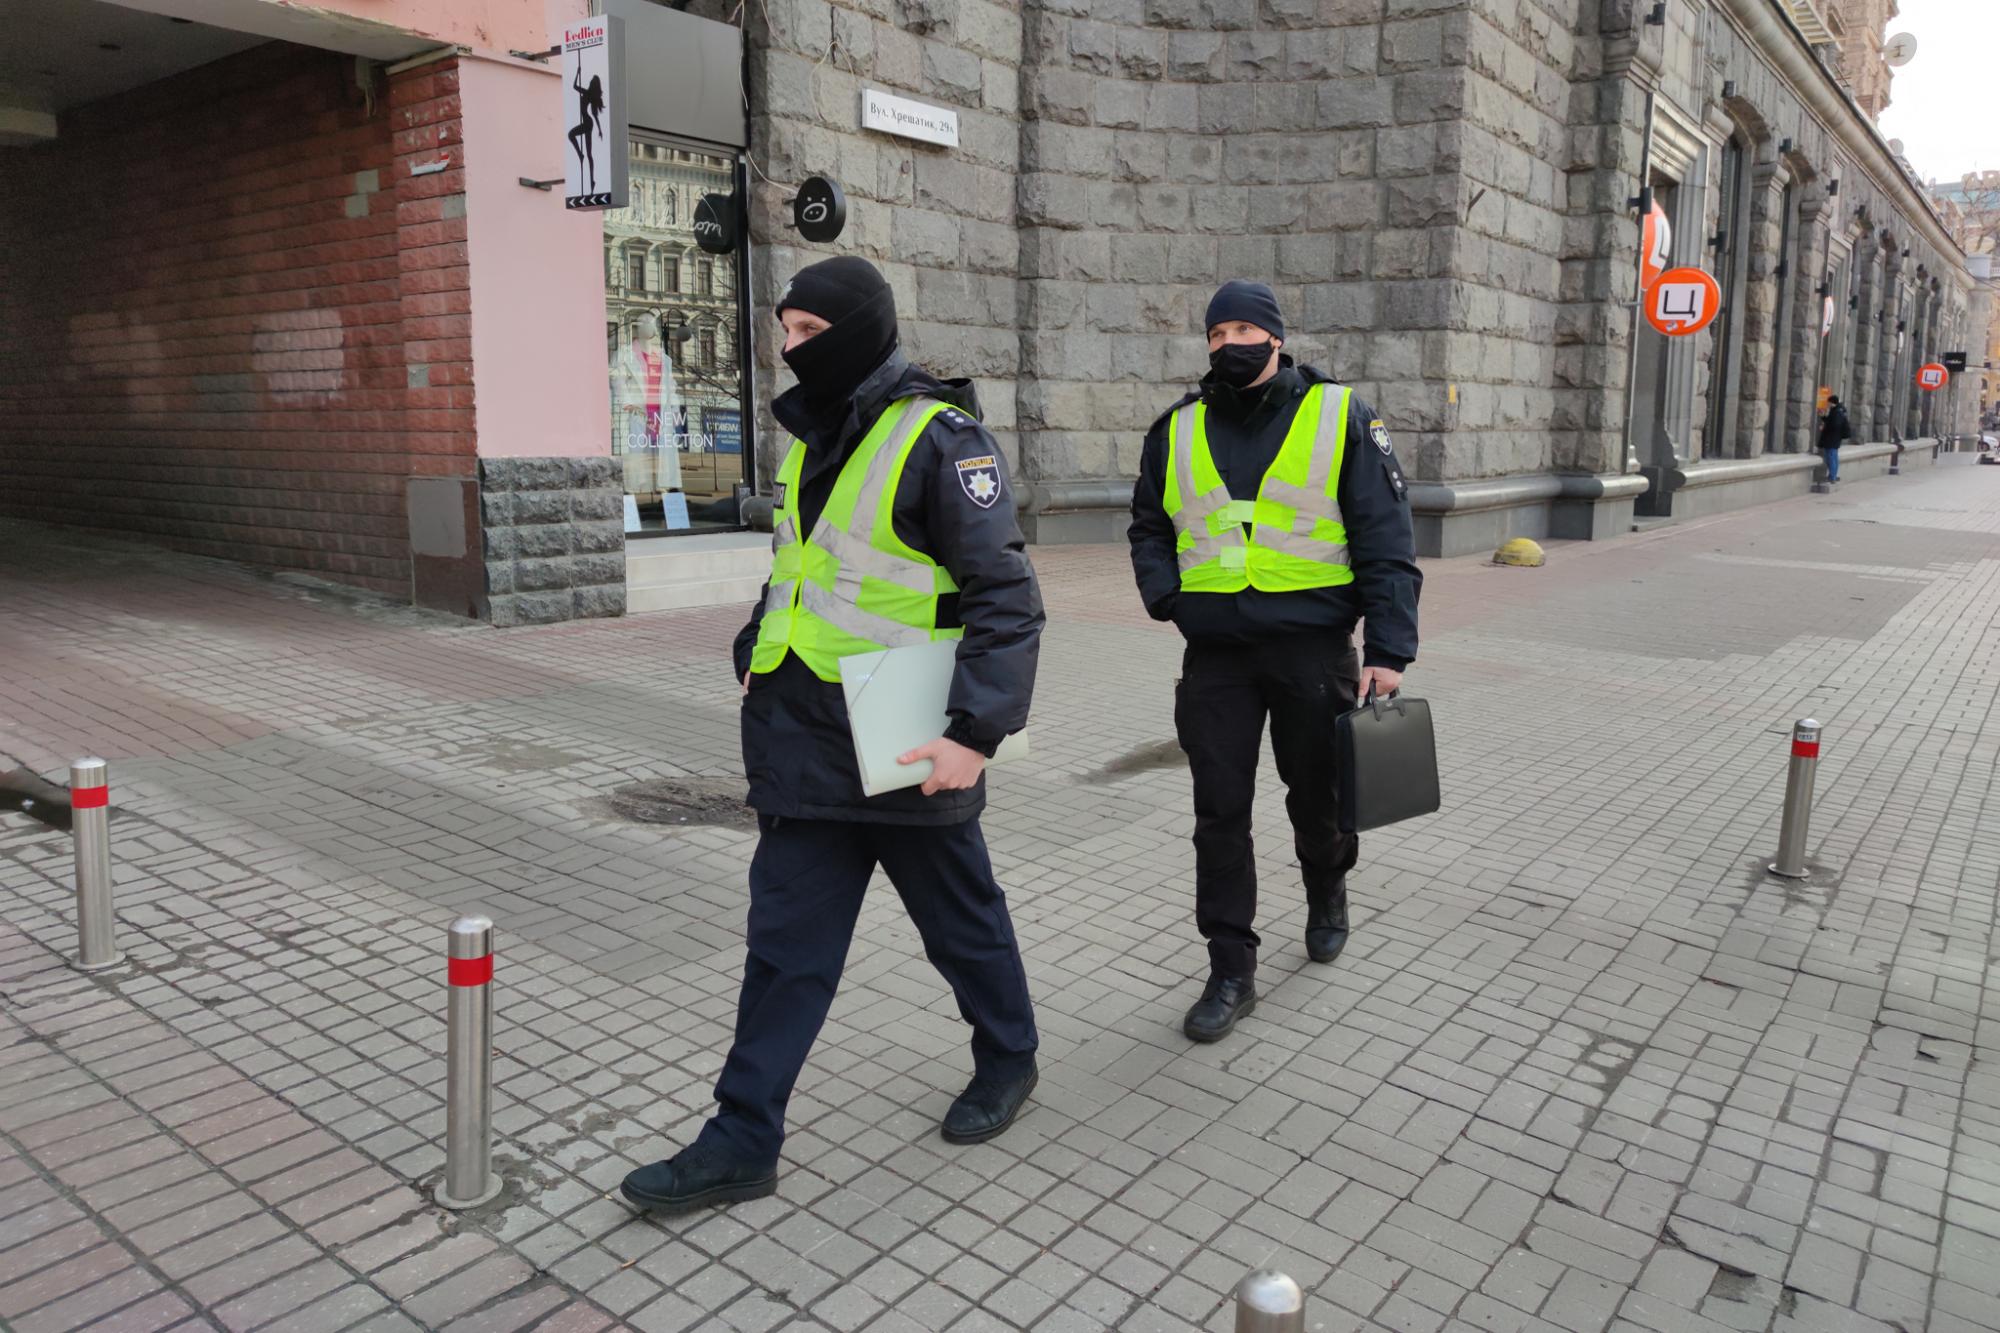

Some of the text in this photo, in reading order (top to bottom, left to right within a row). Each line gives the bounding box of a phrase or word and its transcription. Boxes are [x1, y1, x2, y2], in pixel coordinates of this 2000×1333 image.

[565, 26, 603, 43] Redlion
[1663, 290, 1696, 319] Ц
[653, 412, 687, 426] NEW
[627, 433, 713, 449] COLLECTION
